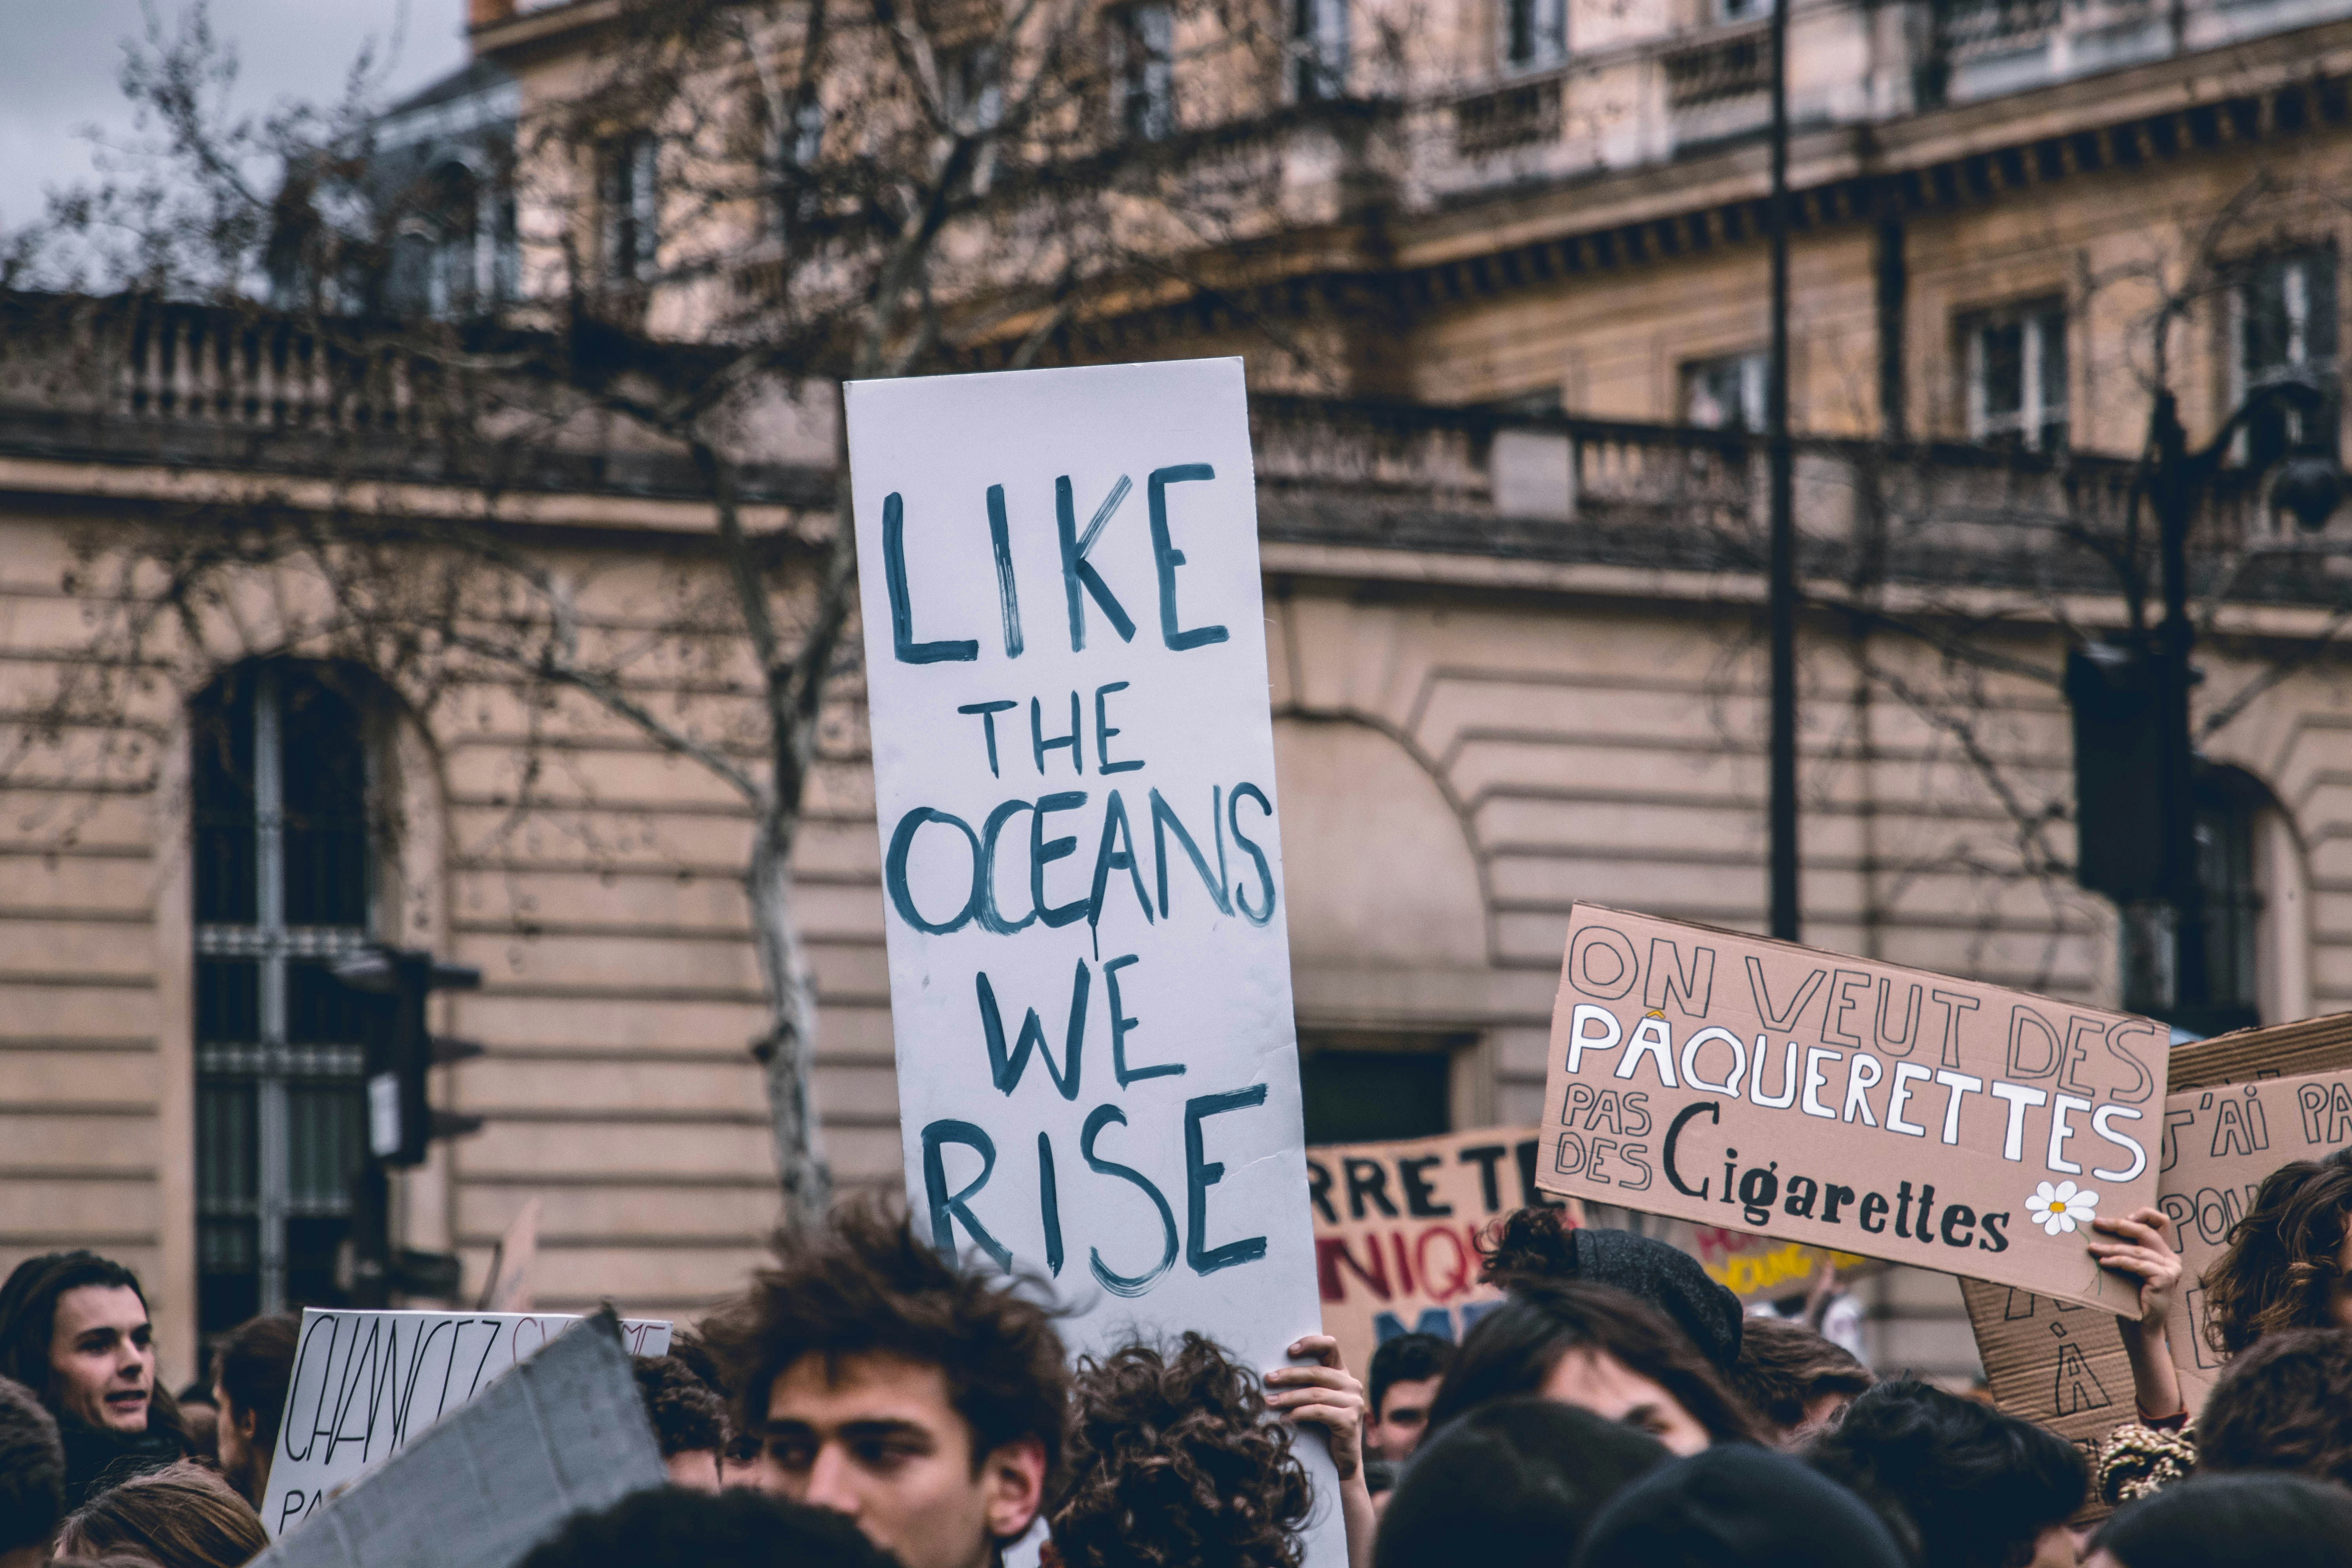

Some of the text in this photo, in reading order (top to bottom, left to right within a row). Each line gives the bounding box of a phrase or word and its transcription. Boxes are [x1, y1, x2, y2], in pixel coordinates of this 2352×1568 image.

[882, 462, 1230, 664] LIKE
[957, 681, 1145, 779] THE
[885, 782, 1275, 938] OCEANS
[975, 953, 1187, 1101] WE
[1568, 926, 2154, 1103] ON VEUT DES
[1555, 1131, 1652, 1191] DES
[1561, 1083, 1652, 1137] PAS
[1565, 1003, 2147, 1183] PÂQUERETTES
[921, 1083, 1269, 1299] RISE
[1662, 1101, 2011, 1253] Cigarettes
